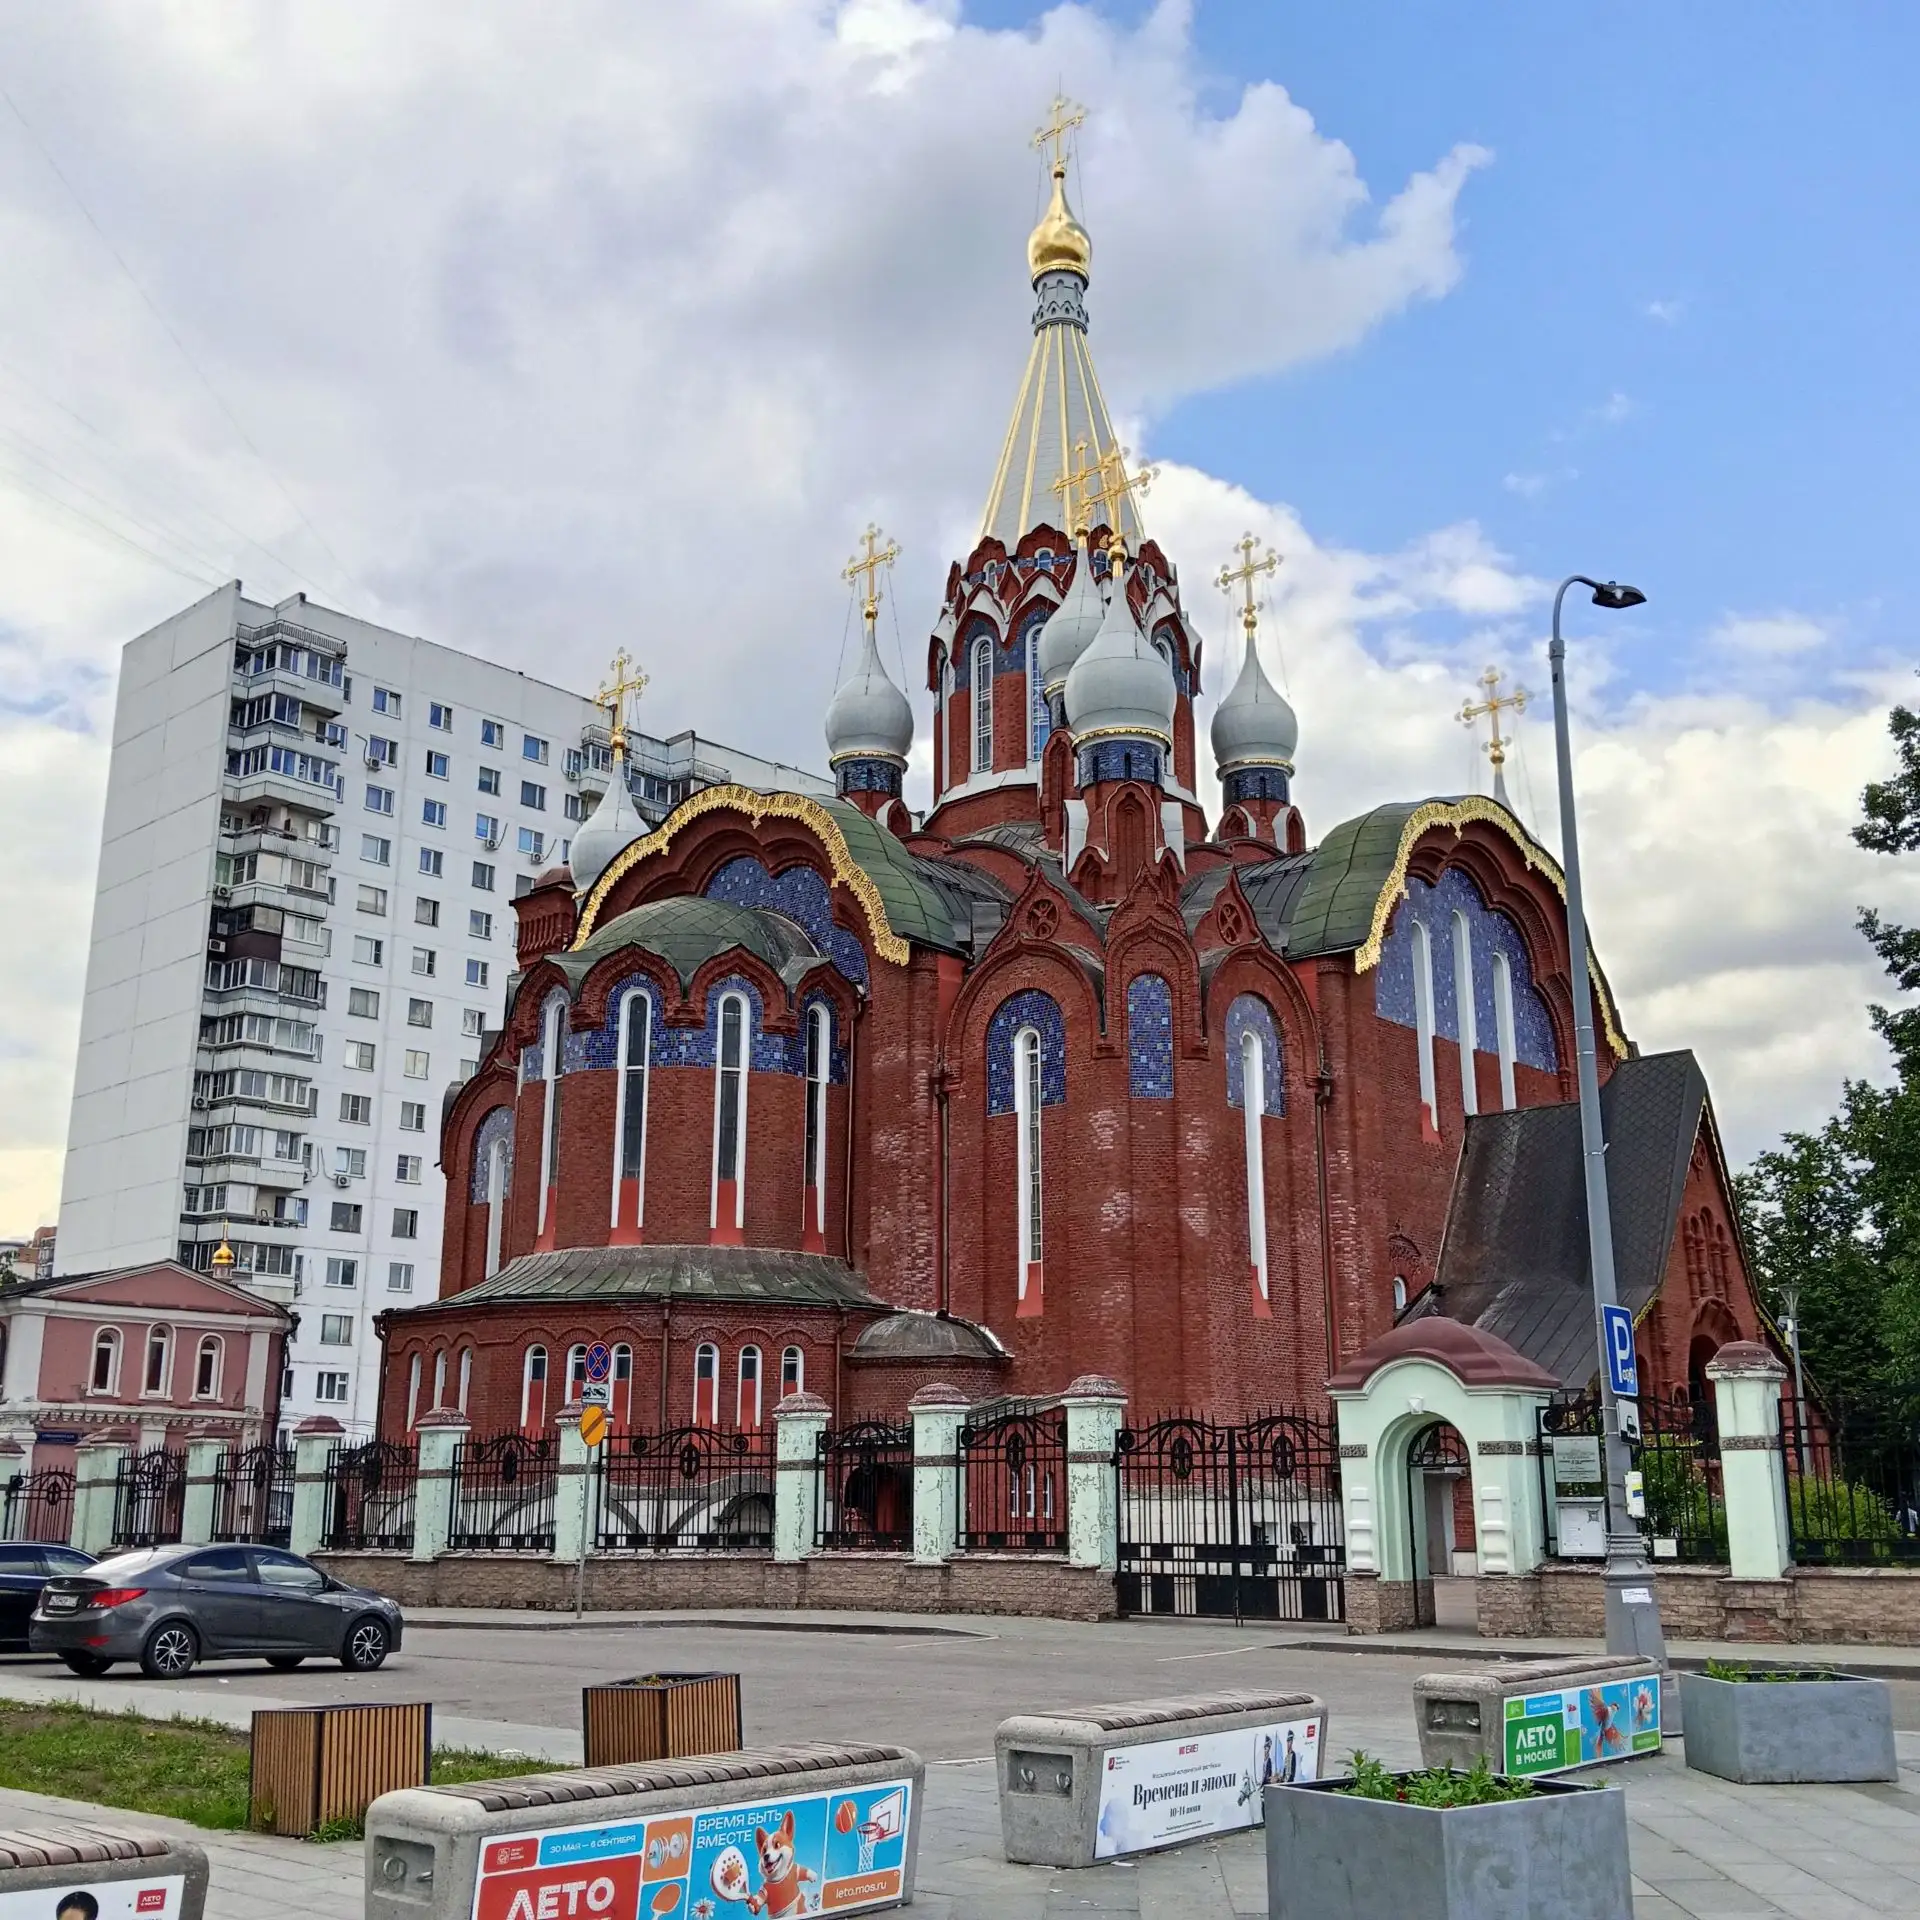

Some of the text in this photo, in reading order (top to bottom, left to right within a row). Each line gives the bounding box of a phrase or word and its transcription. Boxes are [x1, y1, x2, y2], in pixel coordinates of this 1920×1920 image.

[1612, 1315, 1630, 1384] P
[1516, 1724, 1556, 1750] ЛЕТО
[1516, 1748, 1557, 1765] В МОСКВЕ
[1133, 1773, 1237, 1810] Времена и эпохи
[697, 1809, 783, 1832] ВРЕМЯ БЫТЬ
[549, 1845, 561, 1854] 30
[562, 1842, 582, 1852] МАЯ
[590, 1840, 596, 1848] 6
[596, 1834, 636, 1848] СЕНТЯБРЯ
[696, 1829, 752, 1849] ВМЕСТЕ
[505, 1876, 615, 1920] ЛЕТО
[835, 1880, 887, 1899] leto.mos.ru
